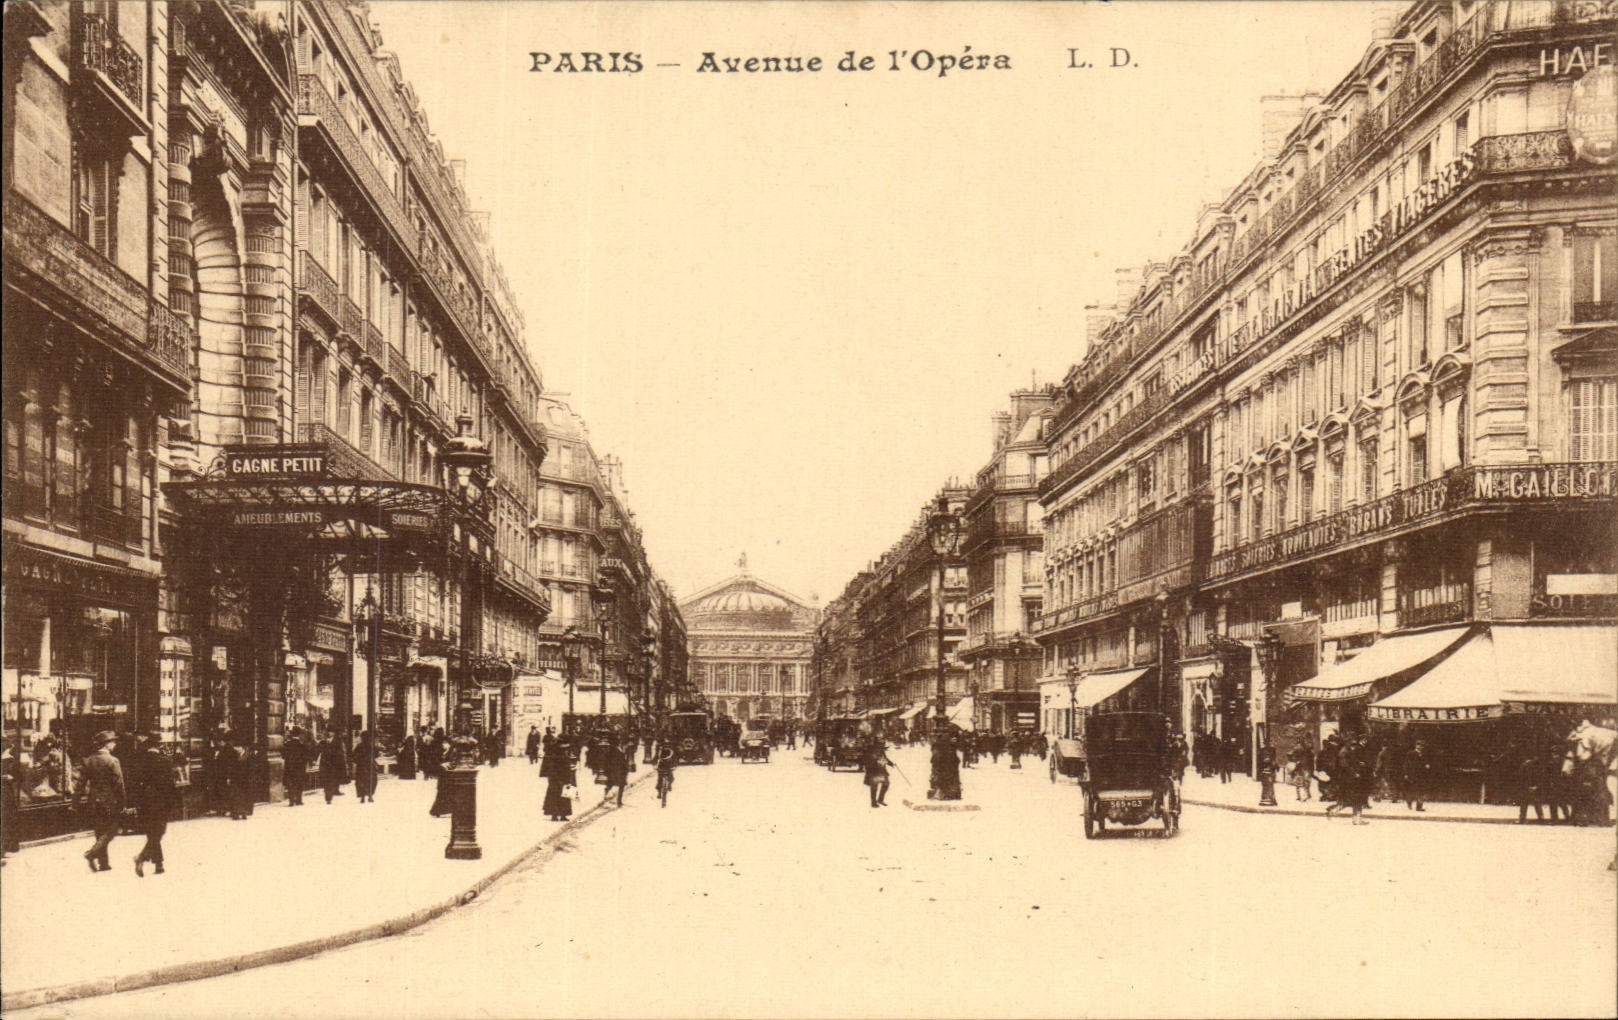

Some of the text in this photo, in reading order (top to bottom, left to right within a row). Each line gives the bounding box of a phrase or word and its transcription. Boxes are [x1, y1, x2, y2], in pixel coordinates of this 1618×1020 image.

[232, 457, 323, 474] GAGNE PETIT
[233, 511, 322, 525] AMEUBLEMENTS
[391, 513, 429, 528] SOIERIES
[1377, 706, 1489, 720] LIBRAIRIE
